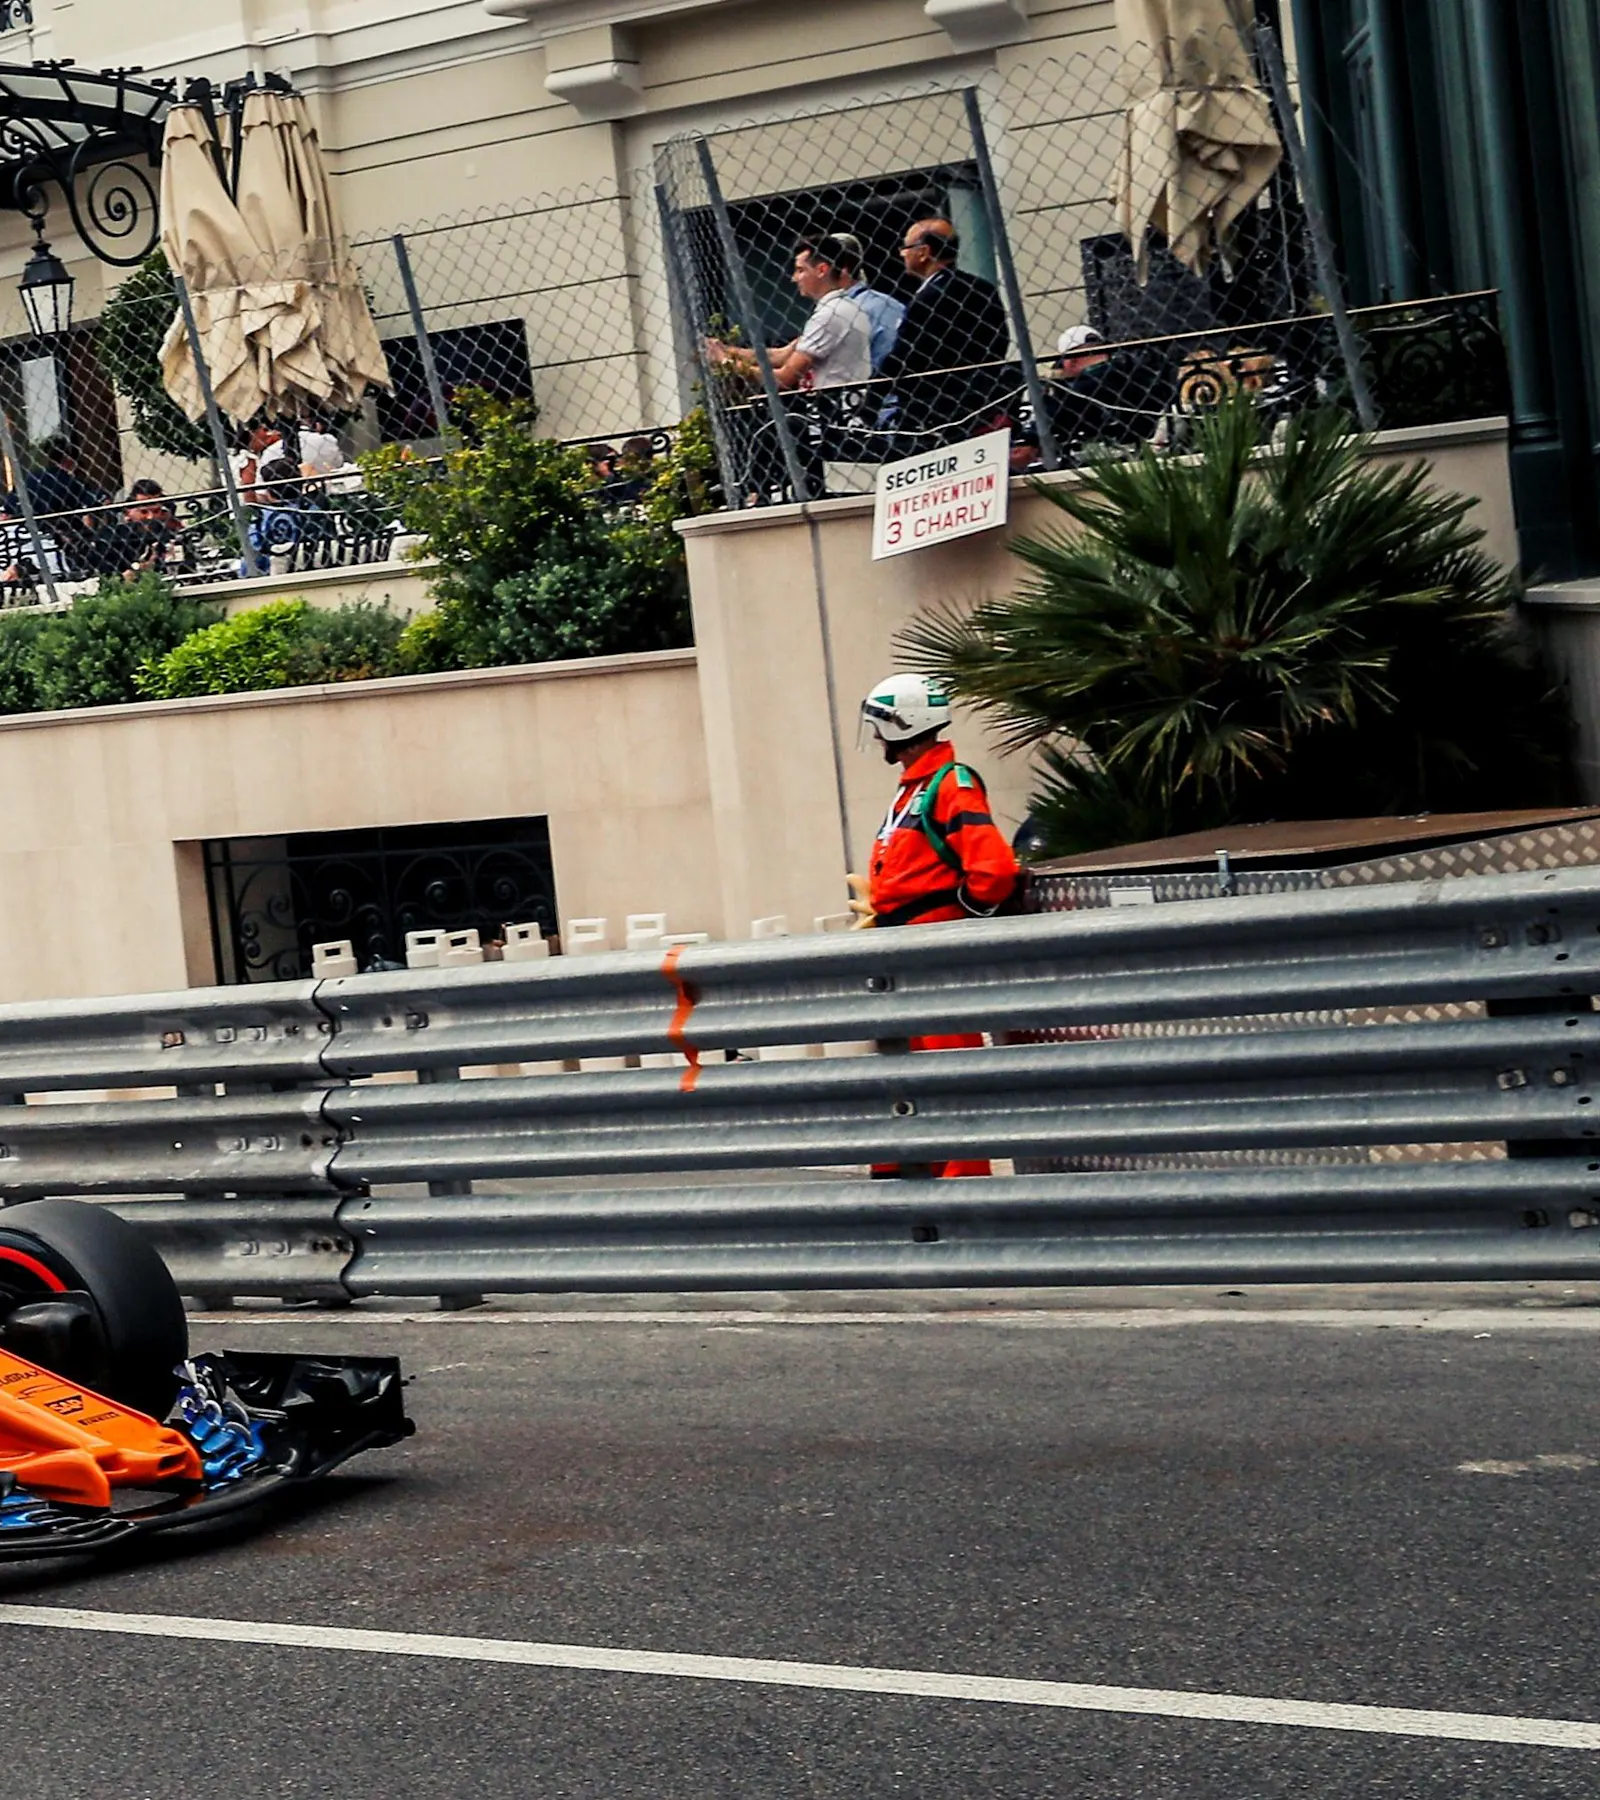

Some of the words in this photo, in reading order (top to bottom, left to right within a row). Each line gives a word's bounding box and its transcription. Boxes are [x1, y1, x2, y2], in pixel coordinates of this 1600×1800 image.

[886, 456, 958, 491] SECTEUR
[974, 448, 986, 464] 3
[887, 474, 996, 519] INTERVENTION
[886, 520, 903, 545] 3
[913, 500, 992, 538] CHARLY
